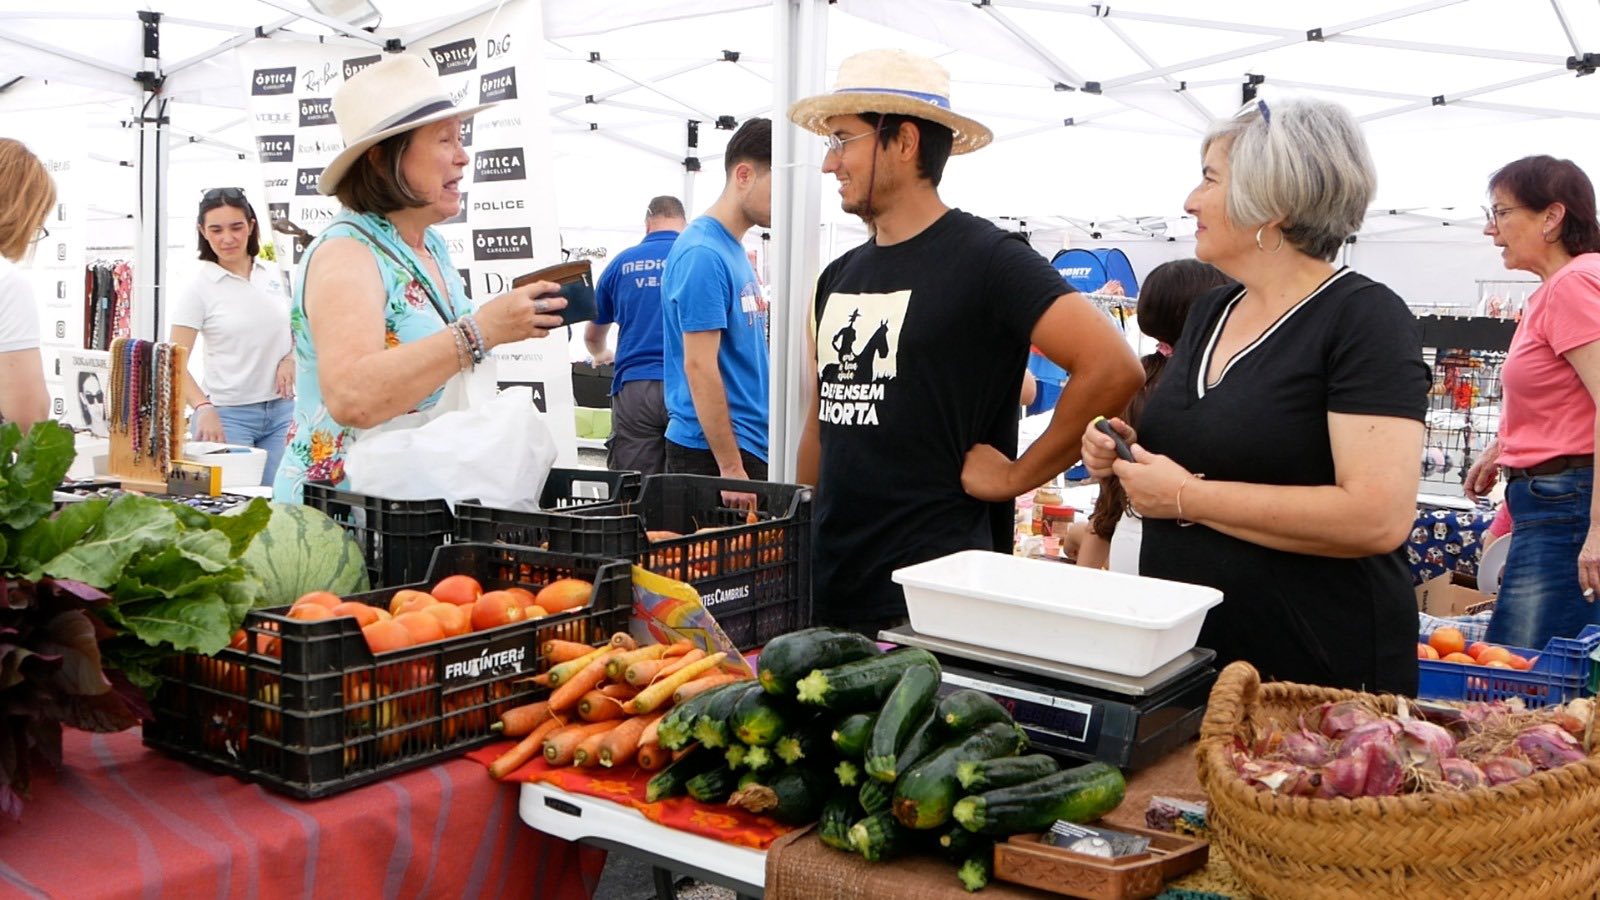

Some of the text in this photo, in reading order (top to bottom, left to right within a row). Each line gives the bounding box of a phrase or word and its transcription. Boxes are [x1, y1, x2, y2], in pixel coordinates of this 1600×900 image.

[487, 34, 511, 59] D&G
[435, 46, 475, 64] ÒPTICA
[255, 73, 293, 85] ÒPTICA
[482, 75, 513, 93] ÒPTICA
[476, 156, 520, 170] ÒPTICA
[474, 200, 525, 211] POLICE
[301, 207, 334, 221] BOSS
[476, 233, 529, 248] ÒPTICA
